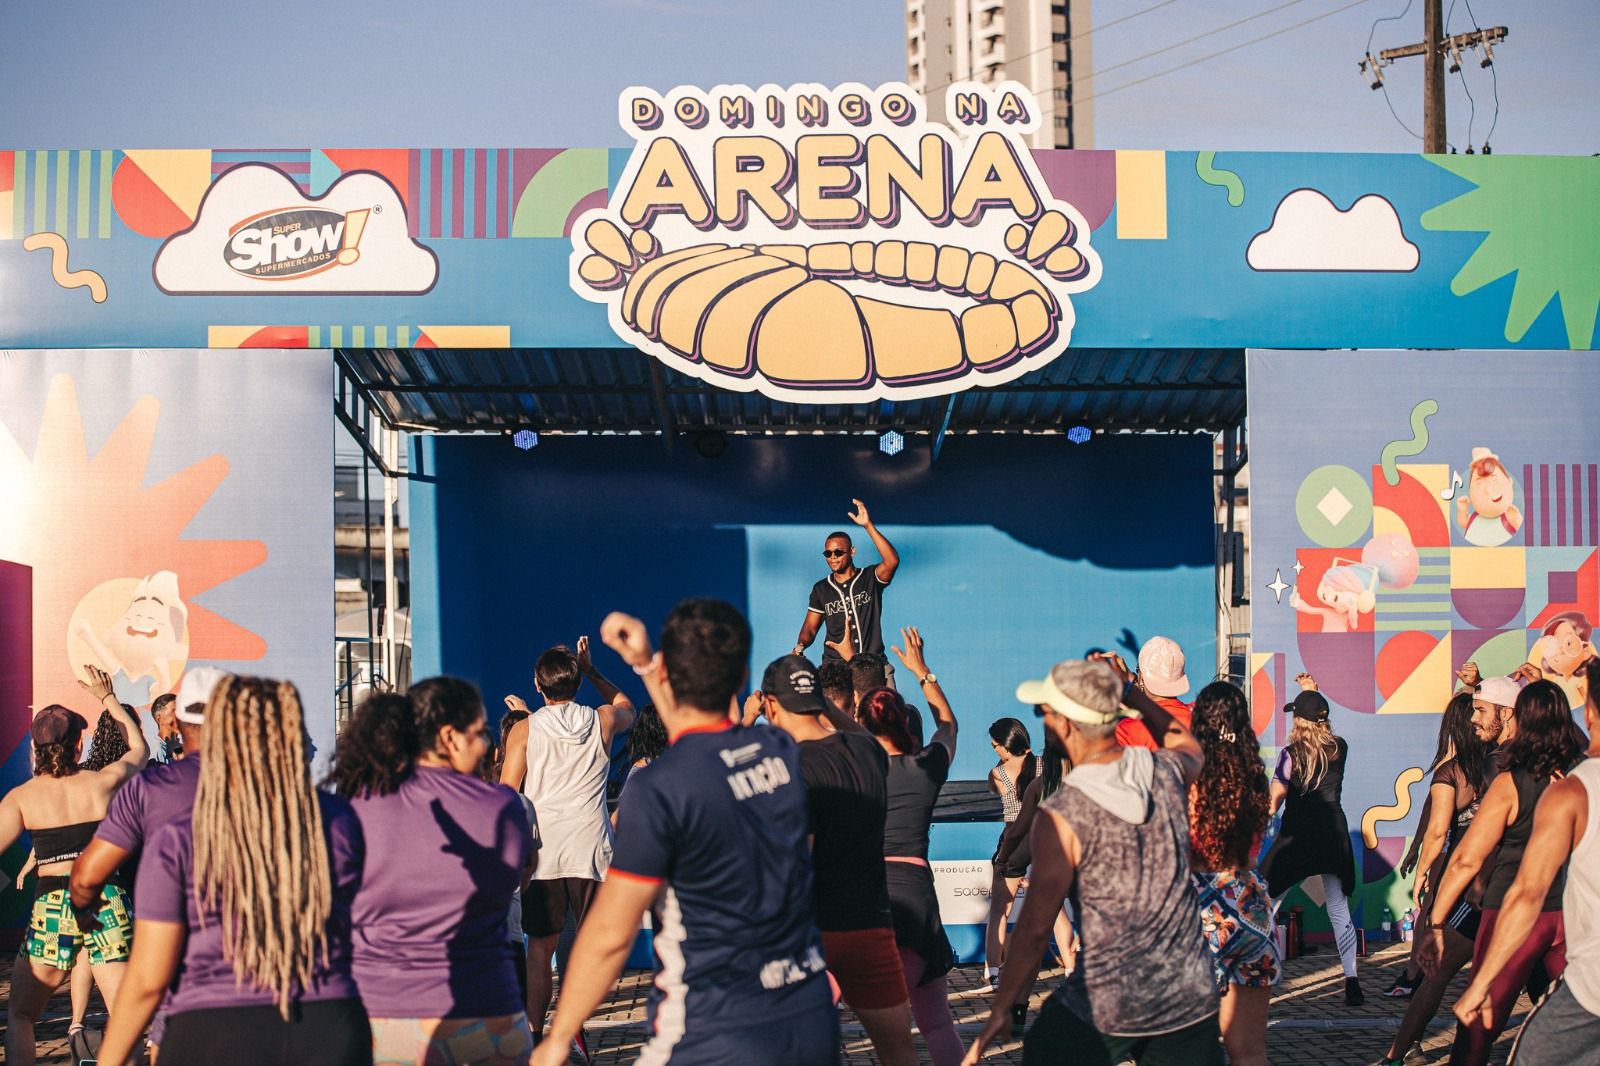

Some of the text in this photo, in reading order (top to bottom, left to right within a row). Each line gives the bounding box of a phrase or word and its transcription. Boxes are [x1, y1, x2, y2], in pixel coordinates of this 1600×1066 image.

[632, 91, 1029, 130] DOMINGO NA
[620, 131, 1049, 231] ARENA
[273, 222, 301, 235] SUPER
[255, 252, 331, 275] SUPERMERCADOS
[934, 866, 984, 875] PRODUÇÃO
